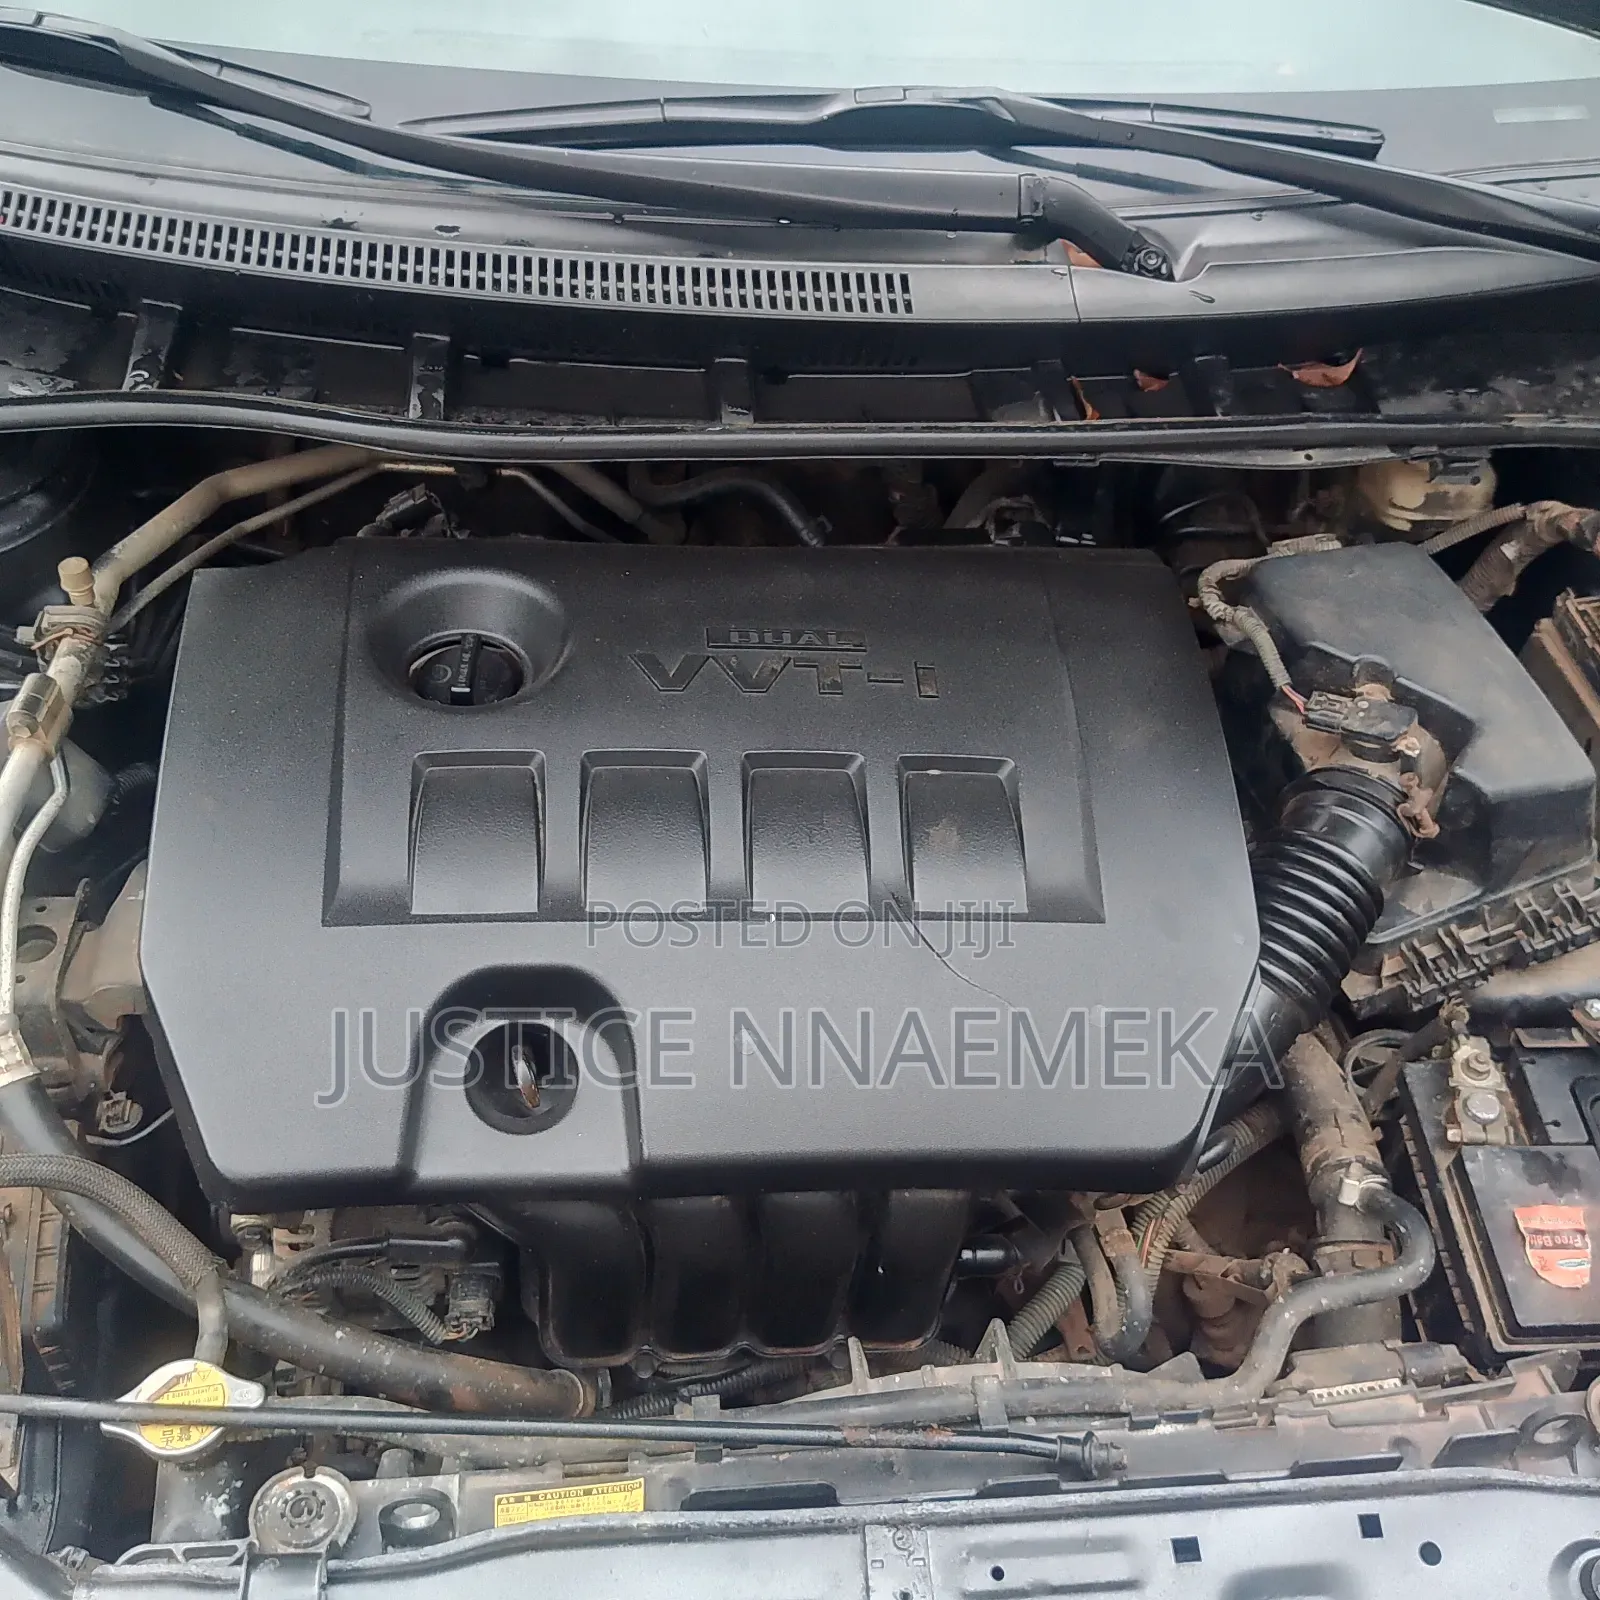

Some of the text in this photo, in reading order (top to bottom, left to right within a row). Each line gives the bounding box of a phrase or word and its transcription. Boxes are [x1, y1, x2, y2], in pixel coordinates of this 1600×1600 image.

[729, 629, 853, 646] DUAL
[1554, 1233, 1582, 1247] Free
[538, 1489, 584, 1501] CAUTION
[592, 1481, 640, 1496] ATTENTION
